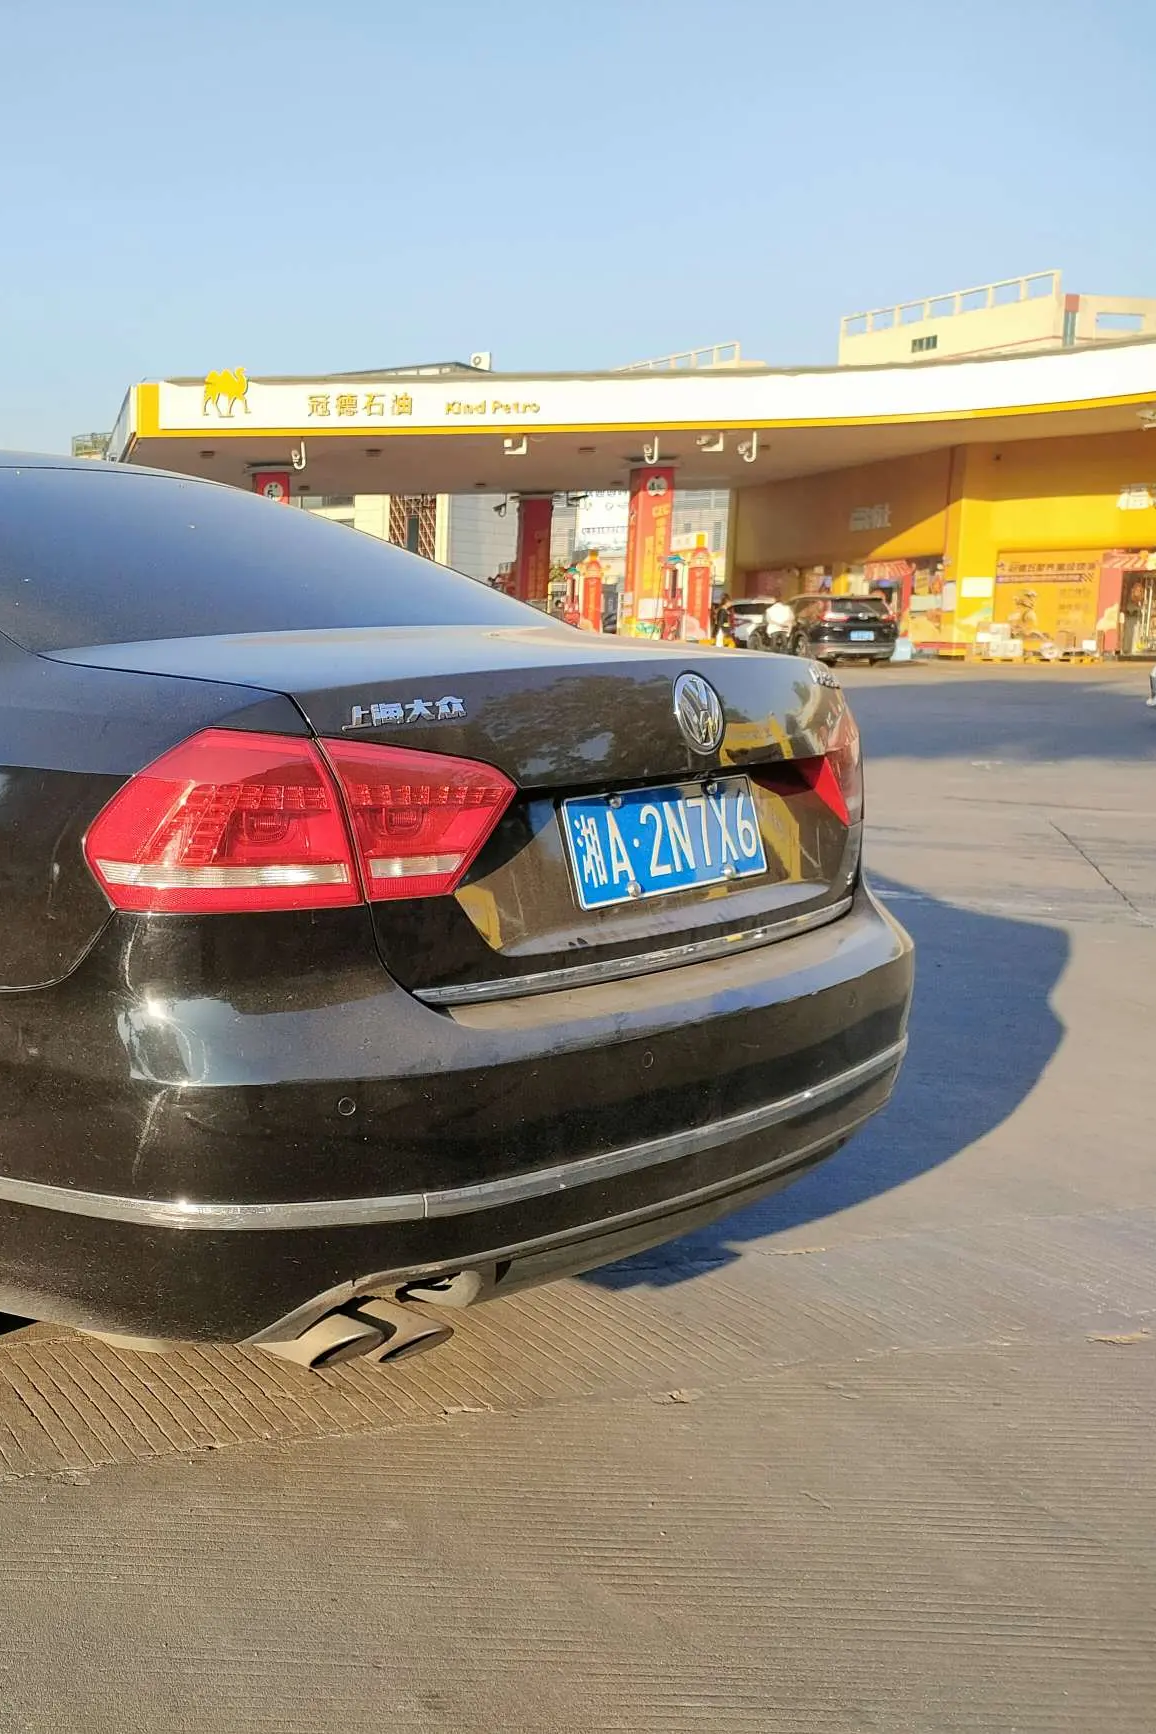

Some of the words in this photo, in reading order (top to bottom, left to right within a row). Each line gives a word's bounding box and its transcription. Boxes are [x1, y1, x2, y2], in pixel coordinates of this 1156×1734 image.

[307, 391, 413, 417] 冠德石油
[444, 399, 486, 416] Kind
[492, 400, 541, 416] Petro
[342, 695, 468, 731] 上海大众
[574, 792, 758, 888] 湘A·2N7X6
